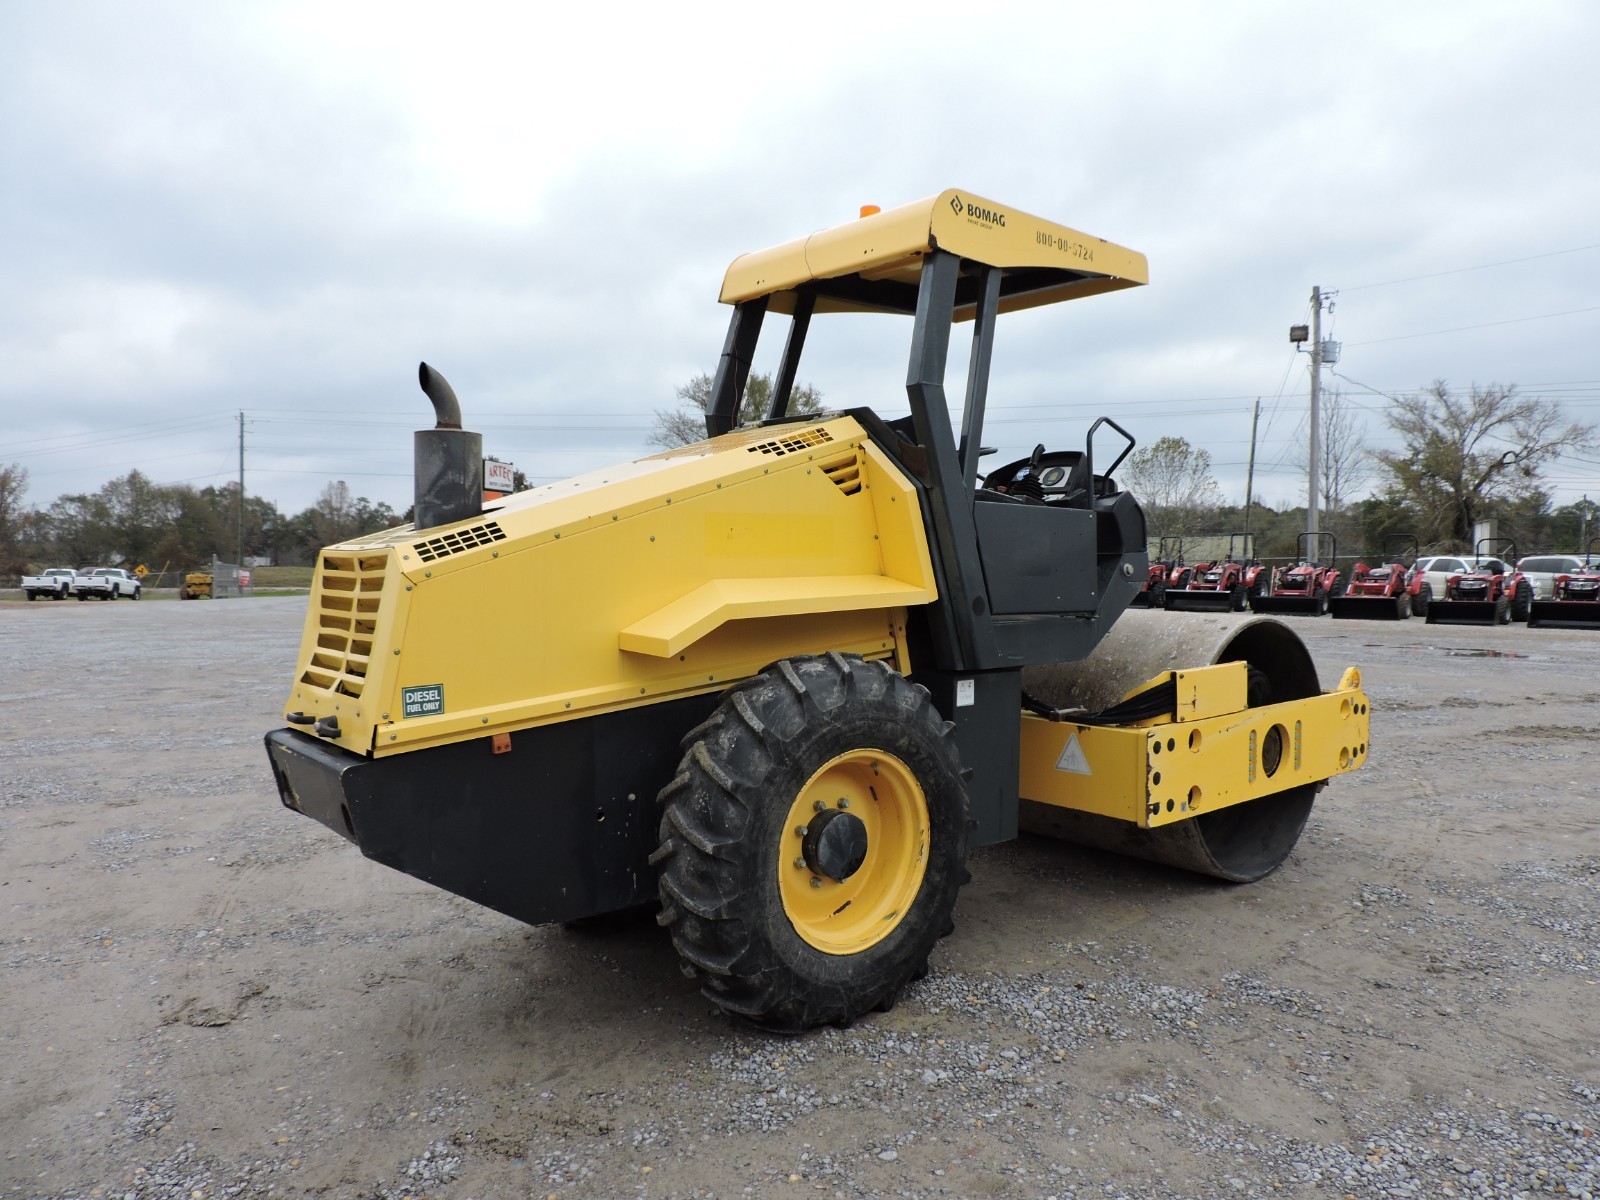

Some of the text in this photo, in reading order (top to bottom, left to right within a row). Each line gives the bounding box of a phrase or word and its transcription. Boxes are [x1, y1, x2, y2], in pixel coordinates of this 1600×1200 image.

[967, 203, 1006, 228] BOMAG
[489, 465, 512, 482] ARTEC
[405, 690, 441, 703] DIESEL
[406, 702, 440, 713] FUEL ONLY
